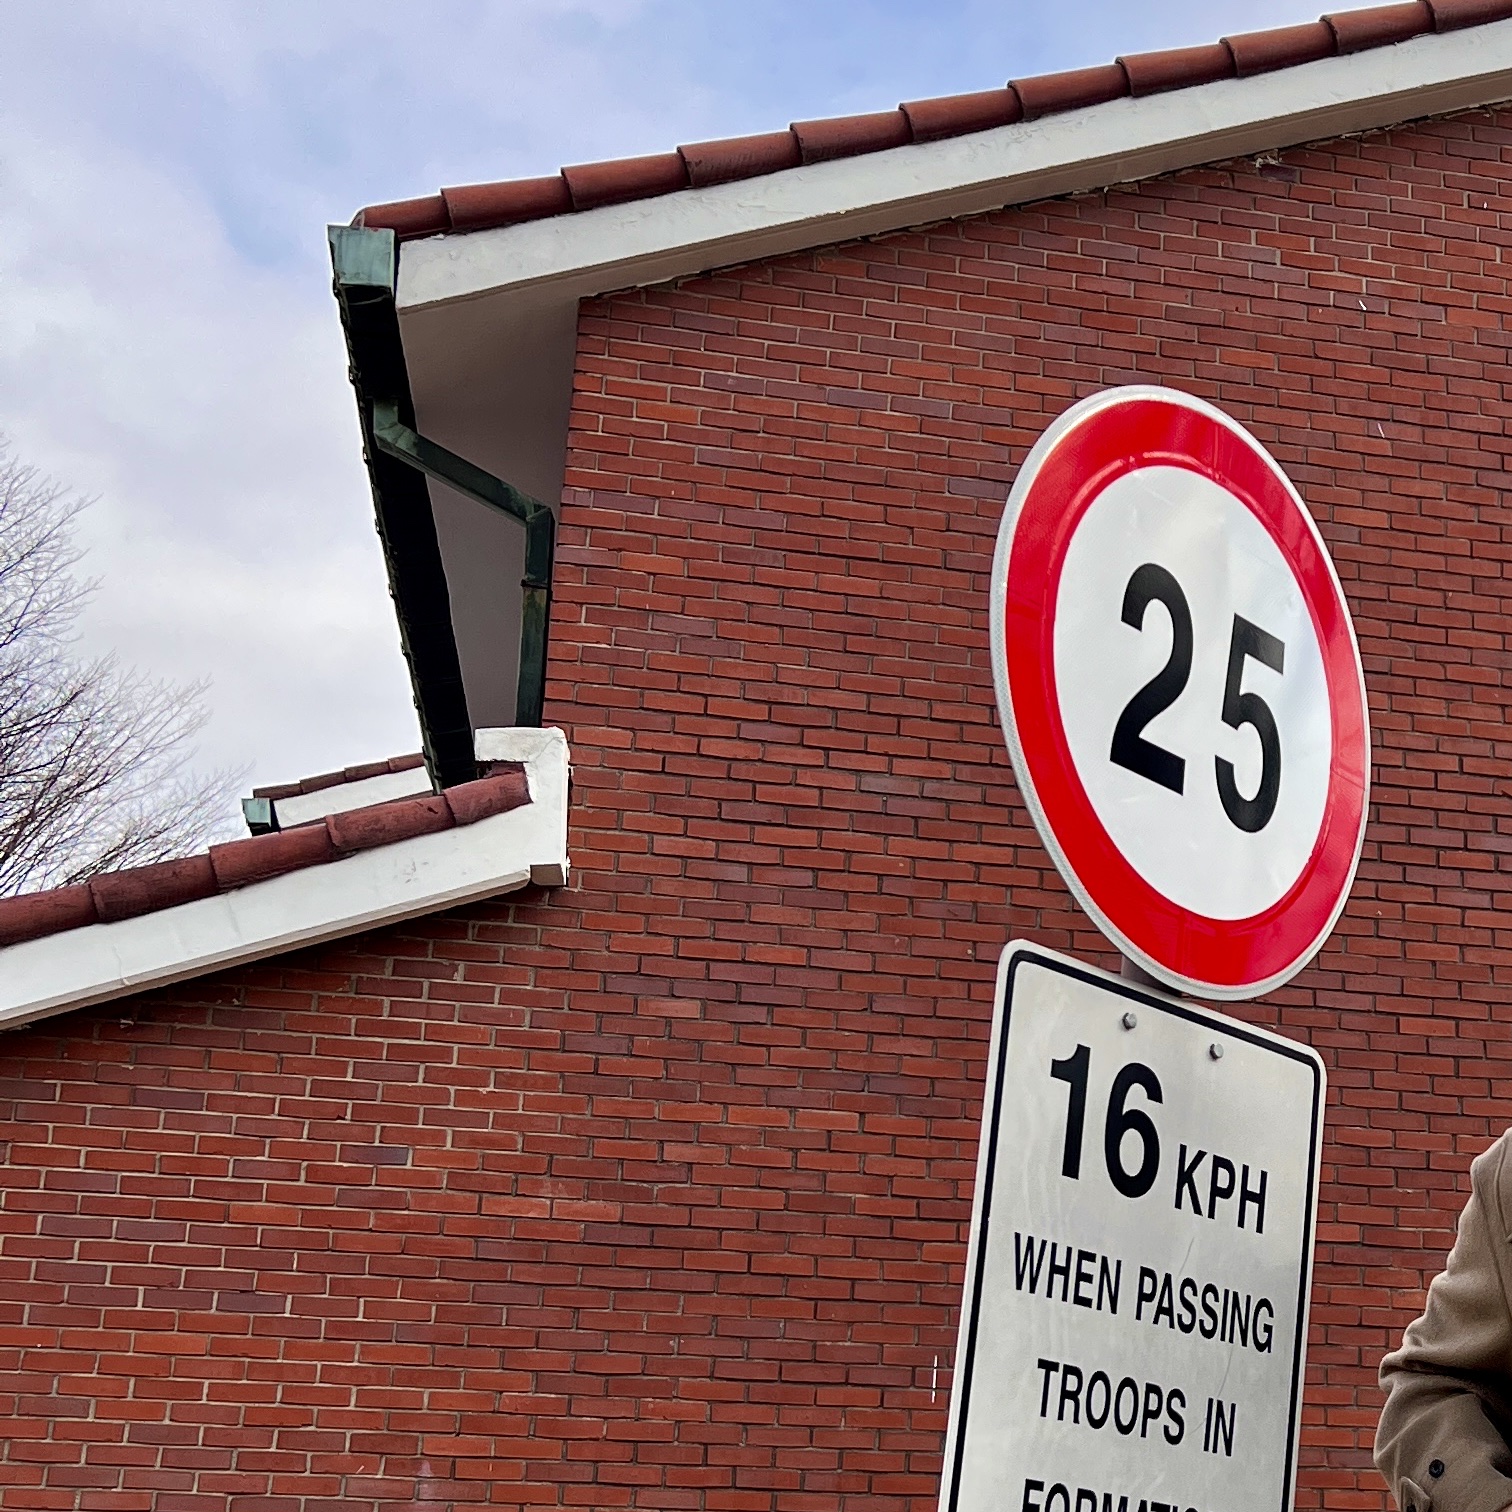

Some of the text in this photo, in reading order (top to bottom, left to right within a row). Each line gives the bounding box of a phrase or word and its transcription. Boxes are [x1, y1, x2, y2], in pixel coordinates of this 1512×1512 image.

[1110, 562, 1286, 834] 25
[1050, 1044, 1268, 1235] 16 KPH
[1014, 1232, 1274, 1354] WHEN PASSING
[1037, 1358, 1236, 1457] TROOPS IN
